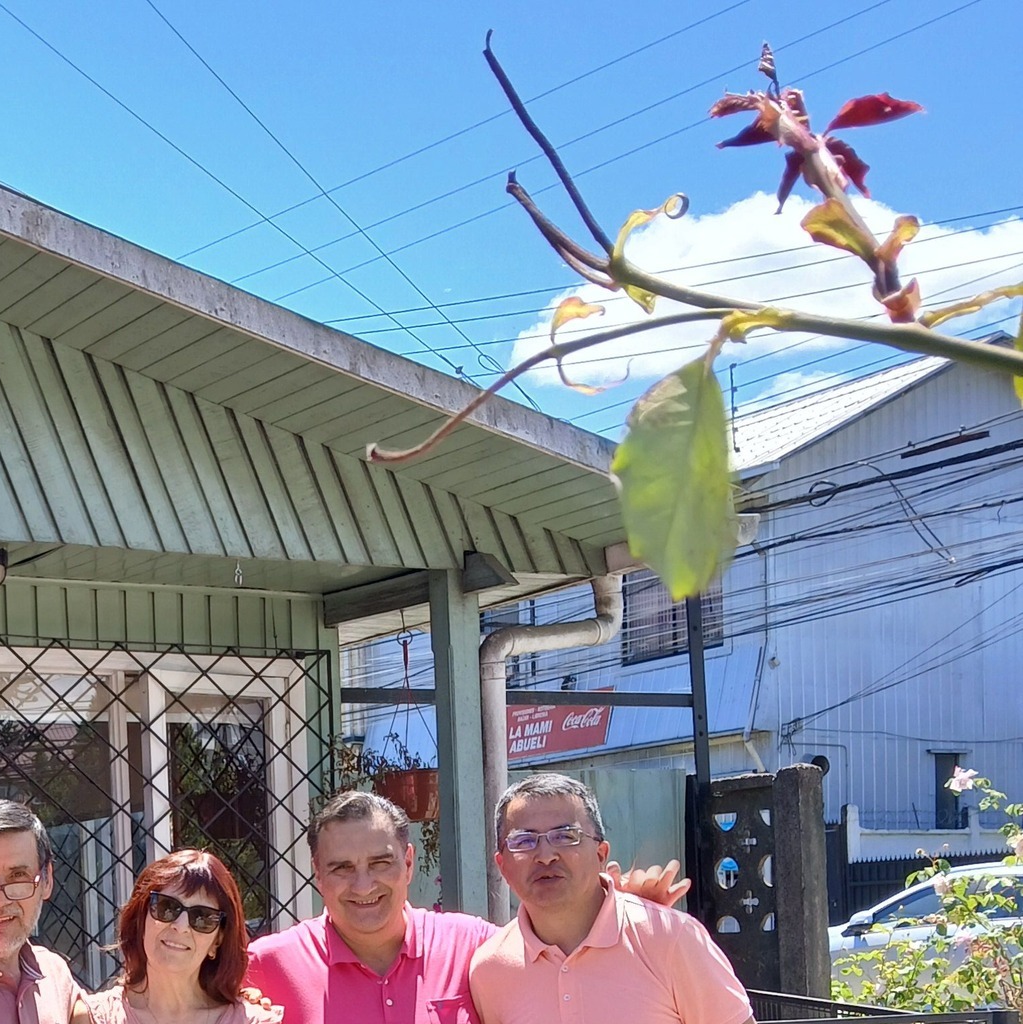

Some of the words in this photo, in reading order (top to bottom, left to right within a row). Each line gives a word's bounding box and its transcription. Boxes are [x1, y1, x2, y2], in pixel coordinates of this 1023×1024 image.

[509, 725, 522, 740] LA
[524, 720, 553, 737] MAMI
[509, 735, 547, 754] ABUELI
